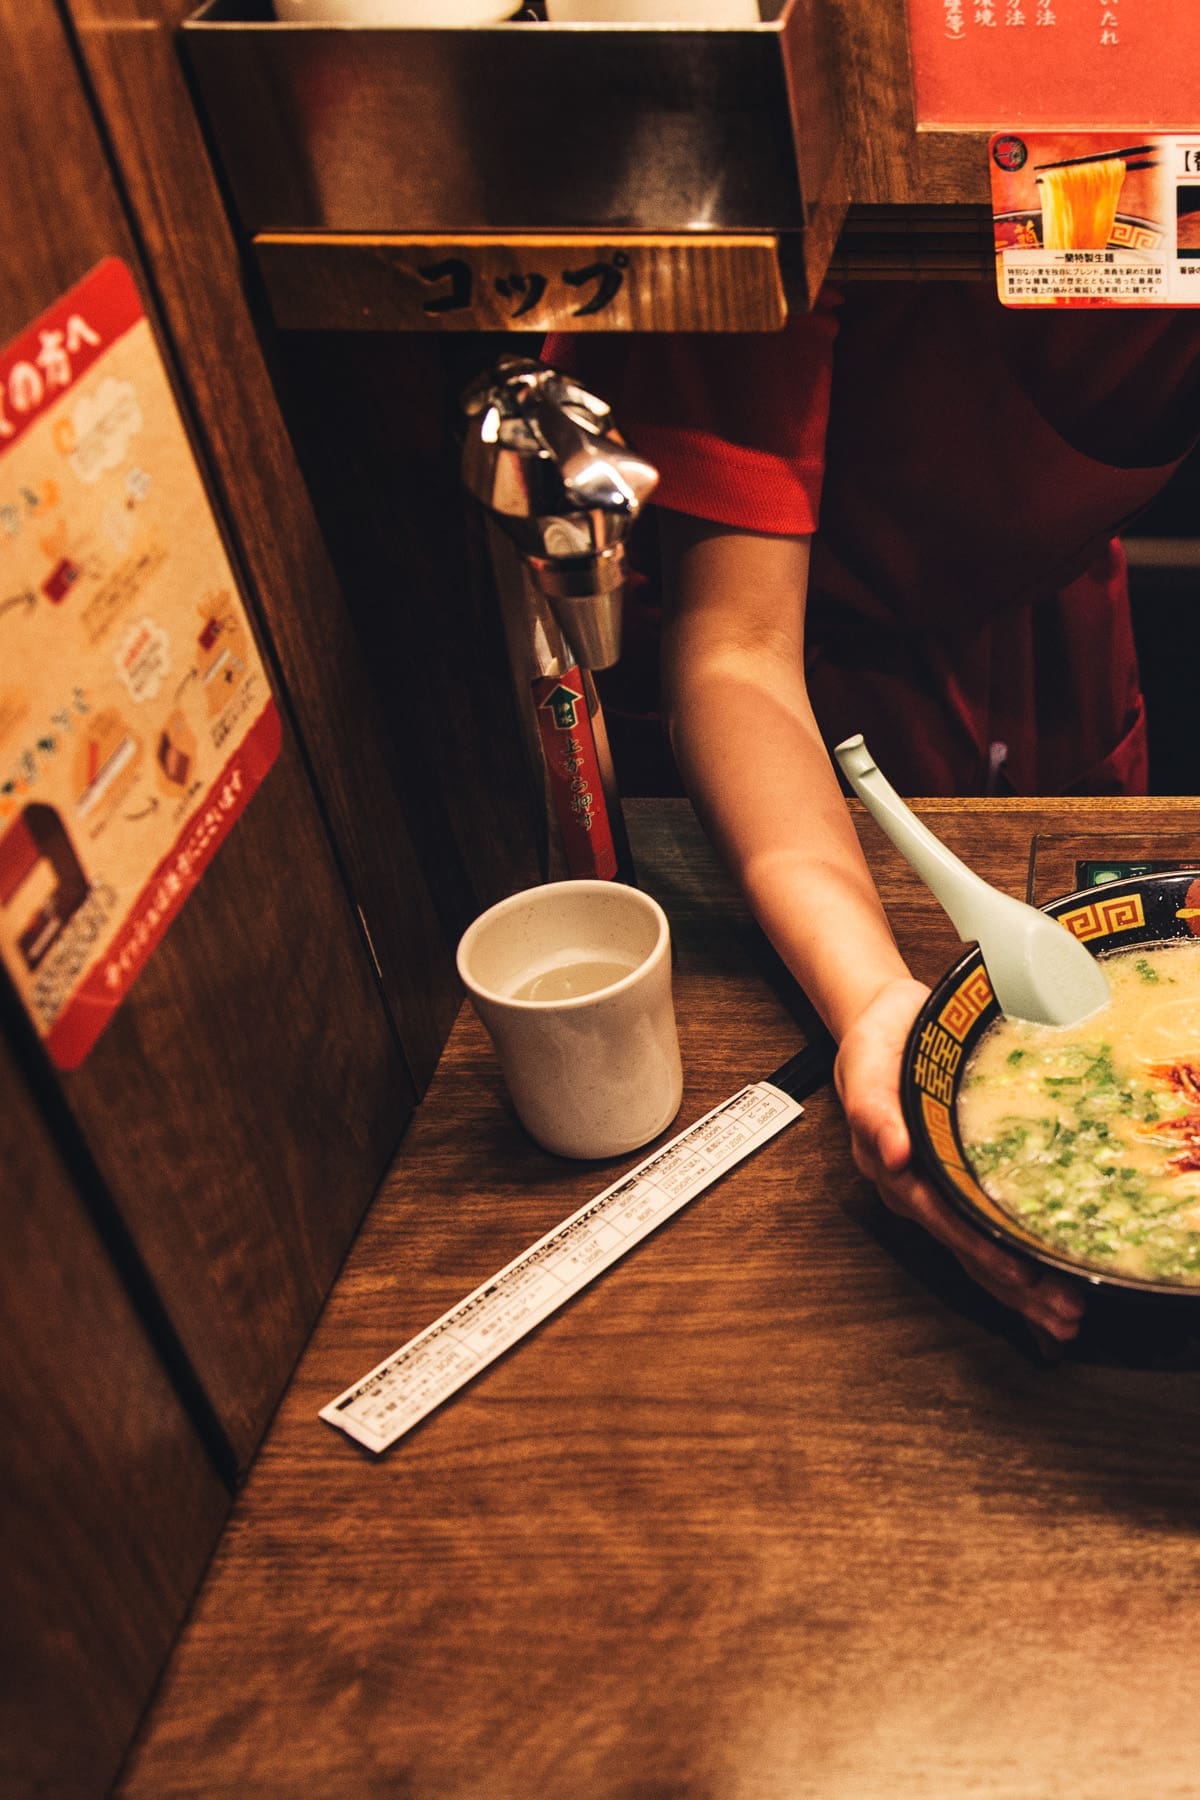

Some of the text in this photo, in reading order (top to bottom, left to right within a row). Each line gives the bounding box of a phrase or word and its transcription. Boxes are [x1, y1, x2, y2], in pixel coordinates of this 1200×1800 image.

[1099, 0, 1119, 46] たれ
[418, 250, 631, 318] コップ
[0, 313, 102, 438] の方へ
